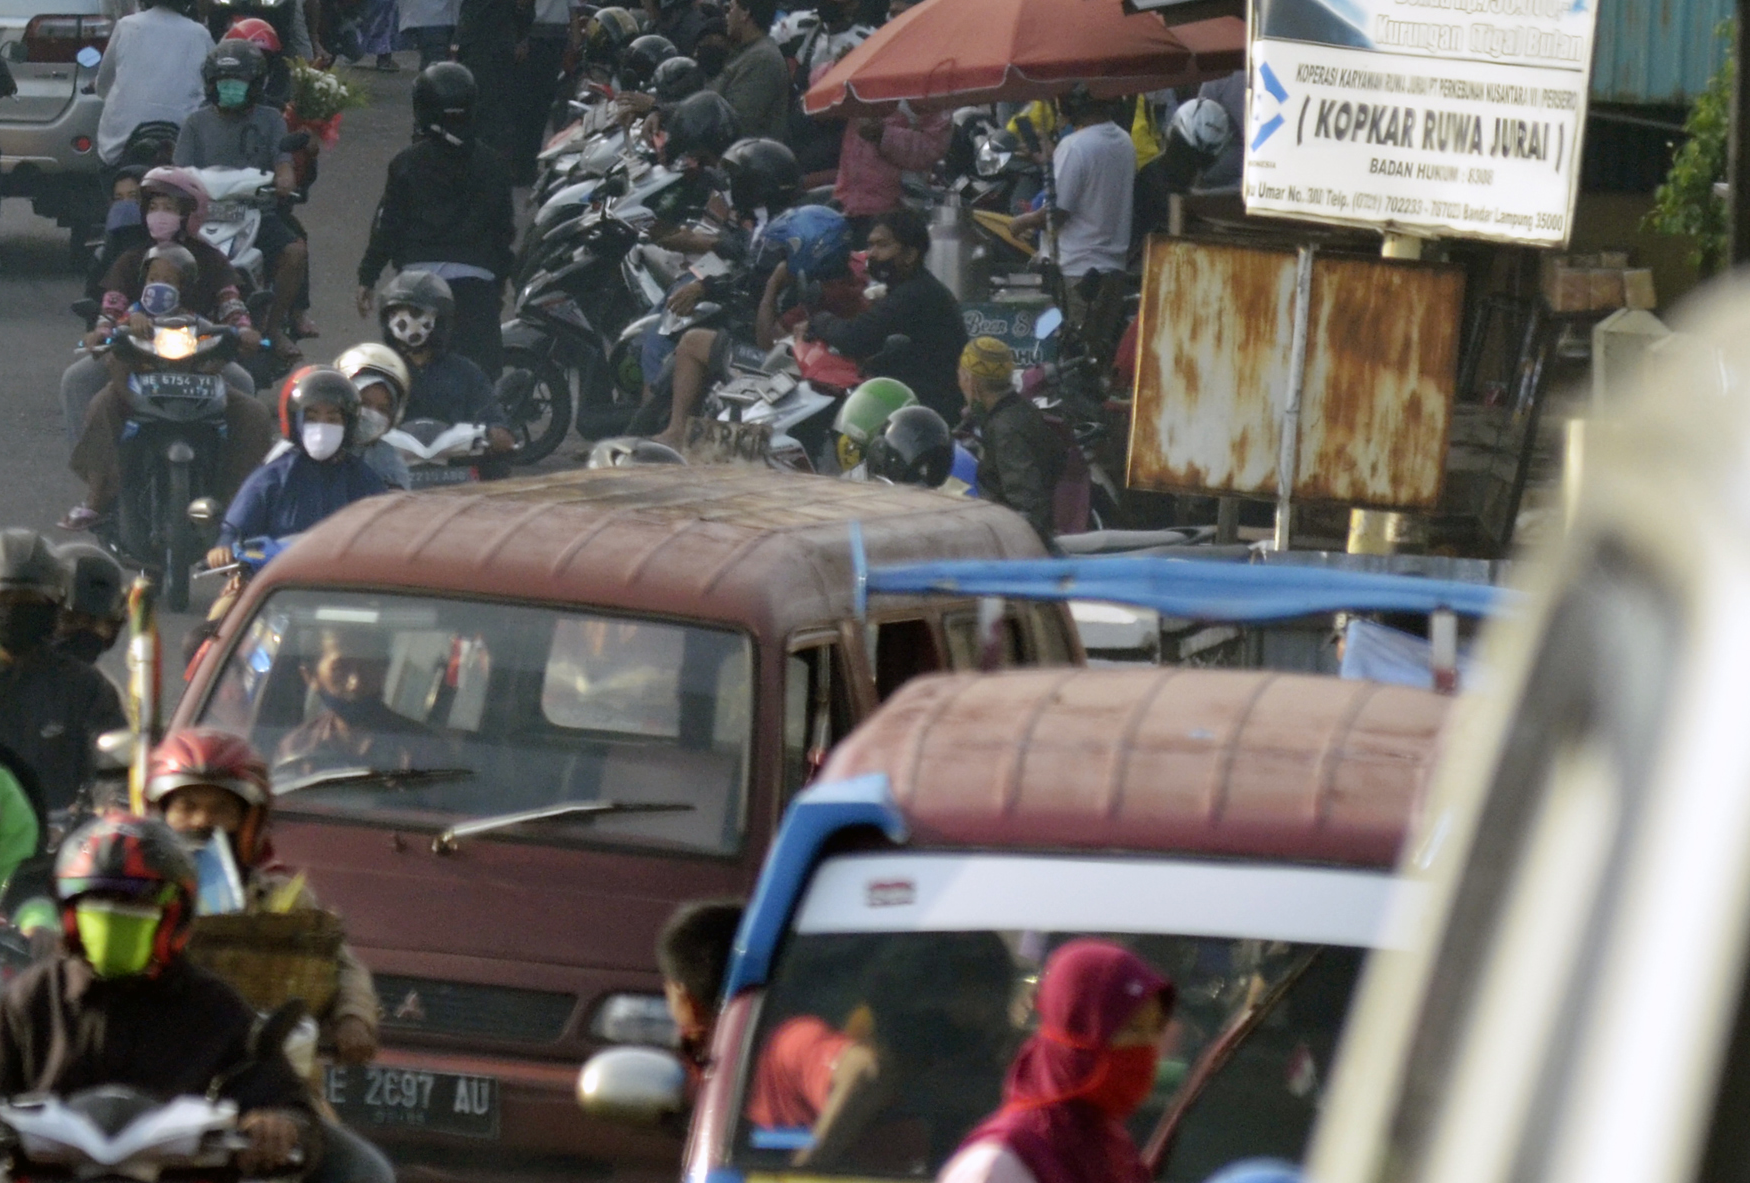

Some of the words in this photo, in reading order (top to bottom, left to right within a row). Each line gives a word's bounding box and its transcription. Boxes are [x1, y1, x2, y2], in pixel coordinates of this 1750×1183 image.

[1375, 14, 1463, 54] Kurungan
[1524, 23, 1586, 62] Bulan
[1314, 98, 1417, 149] KOPKAR
[1421, 108, 1483, 156] RUWA
[1489, 116, 1550, 161] JURAI
[1369, 157, 1413, 179] BADAN
[1258, 180, 1286, 200] Umar
[453, 1077, 490, 1115] AU
